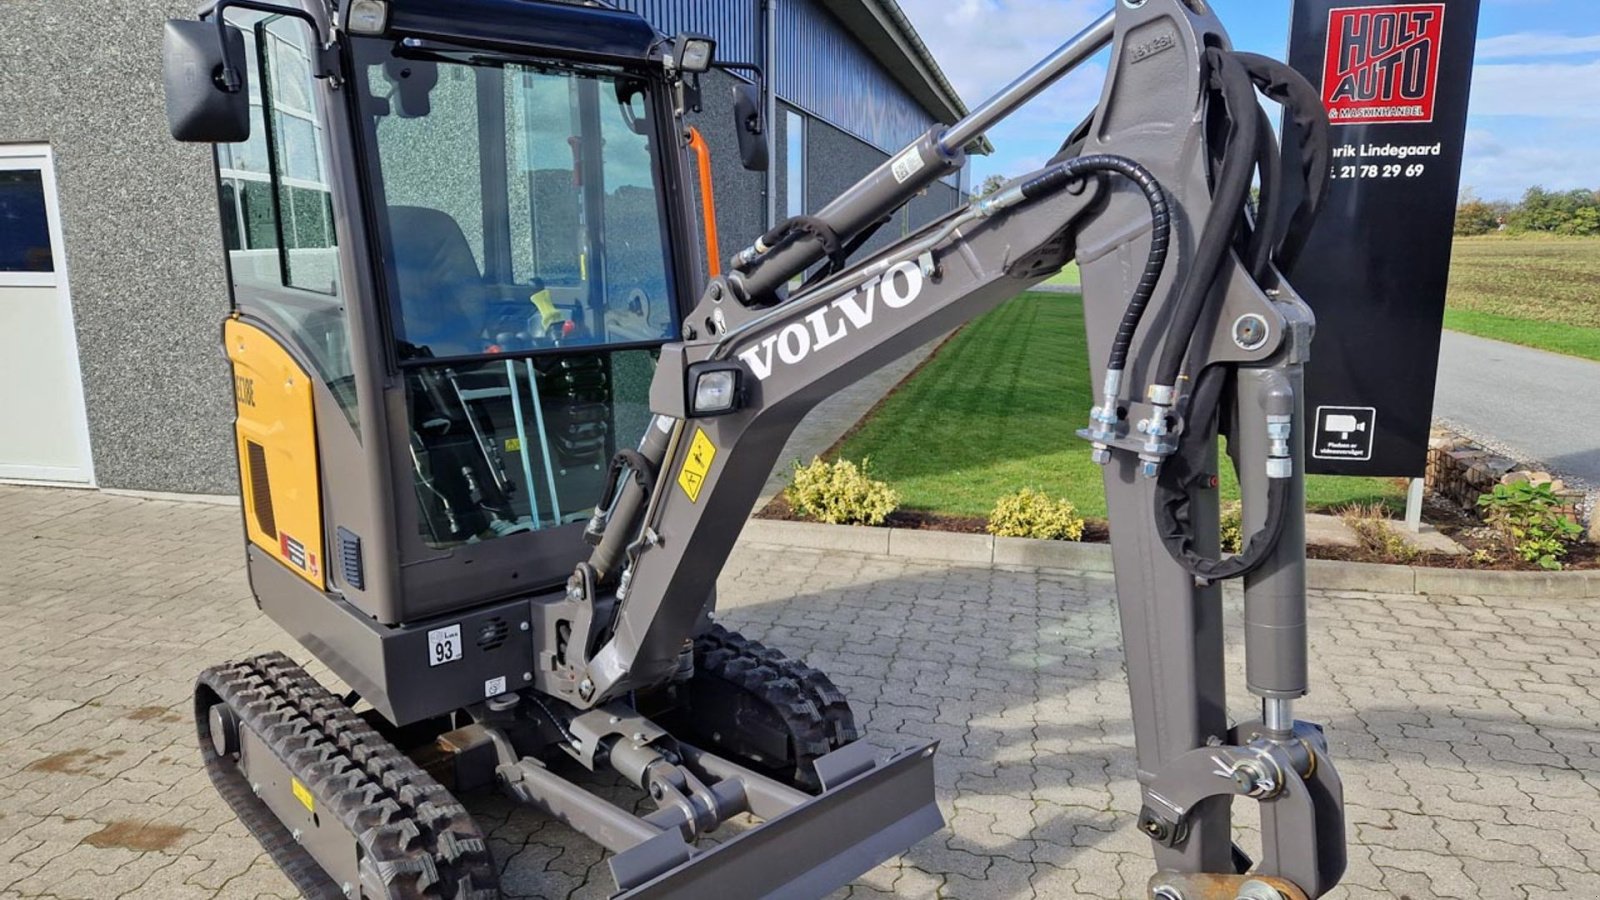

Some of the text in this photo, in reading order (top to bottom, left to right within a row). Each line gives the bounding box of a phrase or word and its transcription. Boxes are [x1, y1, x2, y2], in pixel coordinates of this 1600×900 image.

[1337, 12, 1434, 76] HOLT
[1329, 38, 1431, 102] AUTO
[1339, 105, 1424, 119] MASKINHANDEL
[1360, 142, 1441, 158] Lindegaard
[1340, 165, 1356, 178] 21
[1360, 165, 1379, 178] 78
[1382, 164, 1402, 177] 29
[1405, 164, 1424, 177] 69
[738, 260, 923, 381] VOLVO
[435, 640, 453, 662] 93
